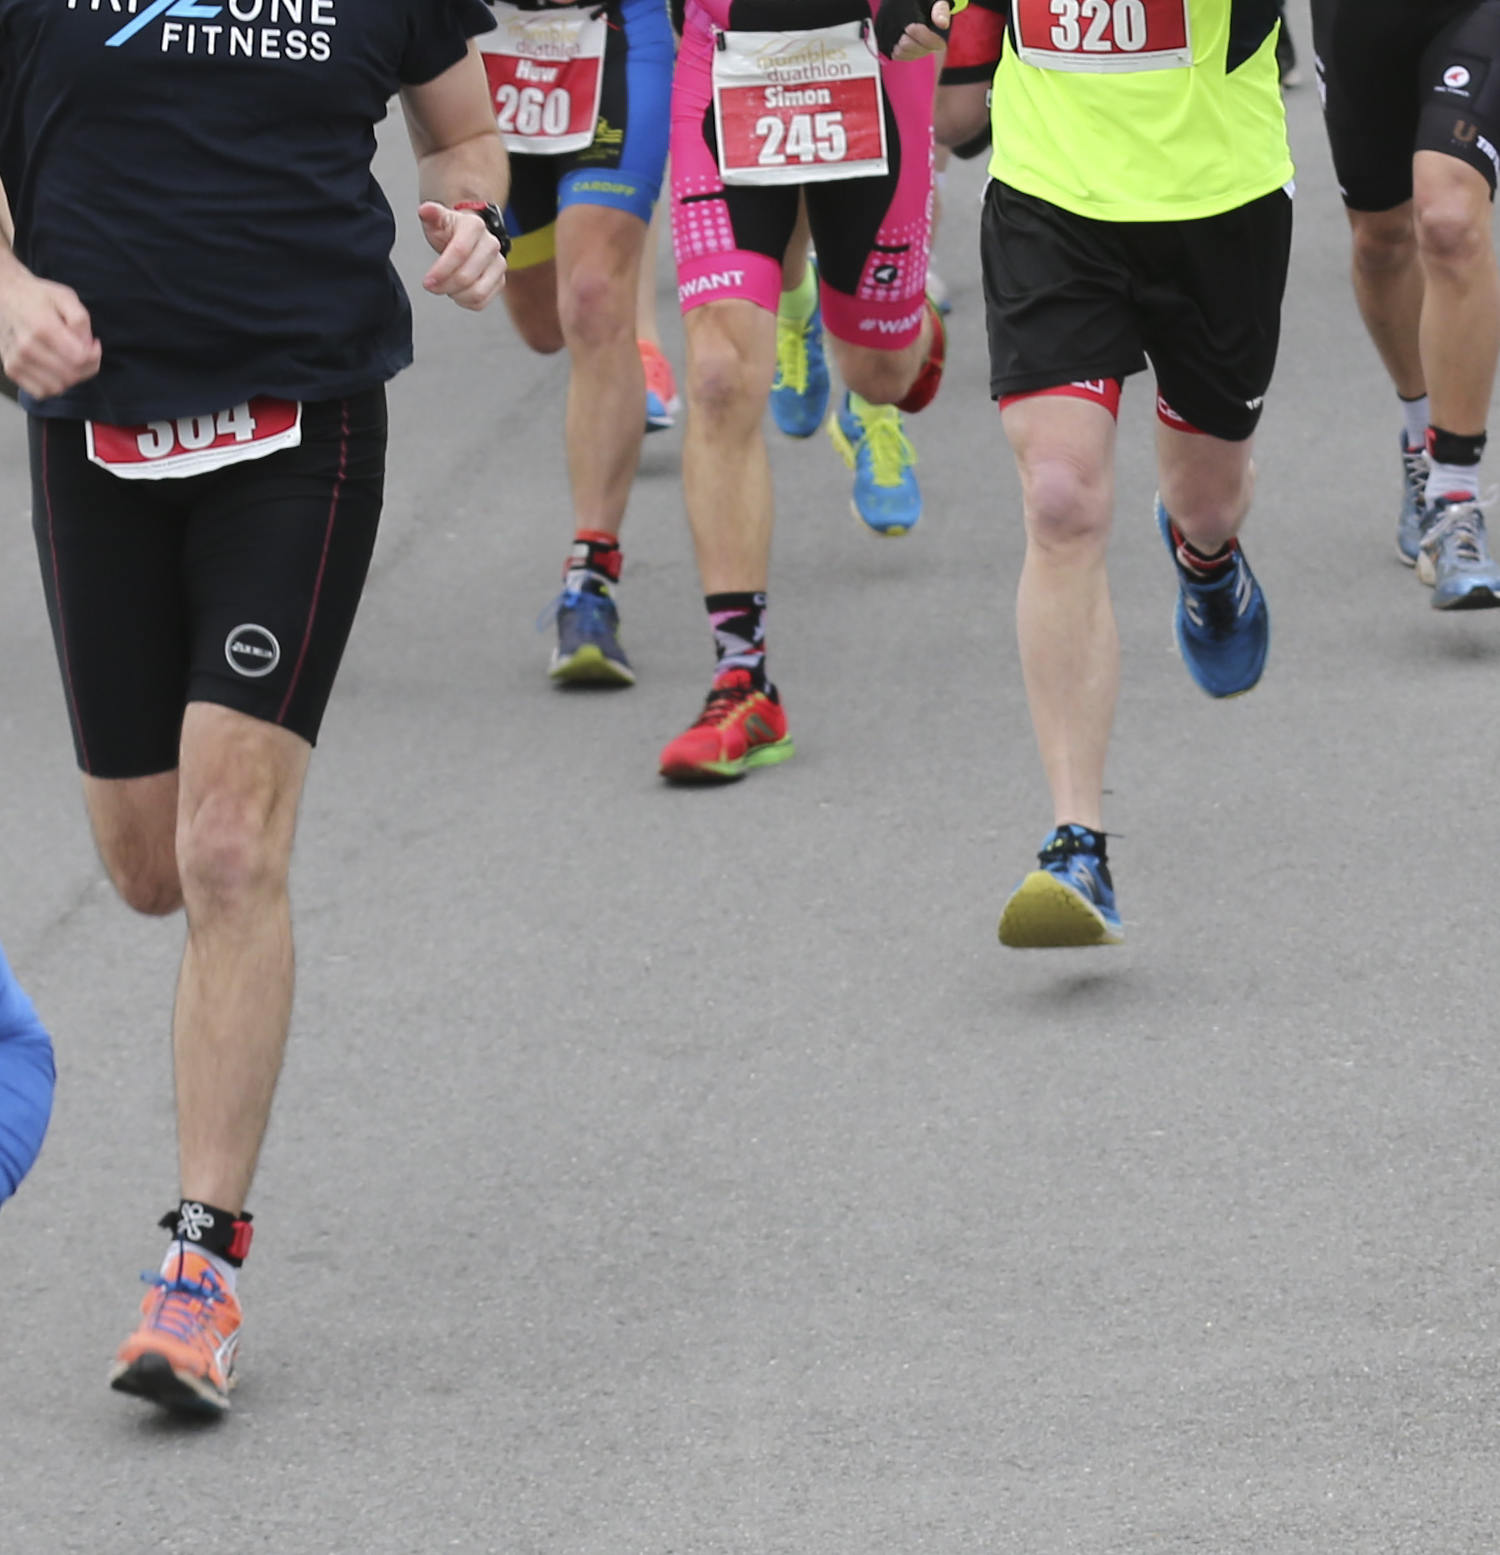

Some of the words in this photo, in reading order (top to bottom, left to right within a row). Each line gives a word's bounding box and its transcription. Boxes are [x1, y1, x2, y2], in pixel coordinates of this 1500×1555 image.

[161, 21, 331, 61] FITNESS
[515, 59, 559, 83] Huw
[767, 60, 852, 82] duathlon
[495, 84, 571, 136] 260
[764, 85, 832, 108] Simon
[755, 111, 848, 165] 245
